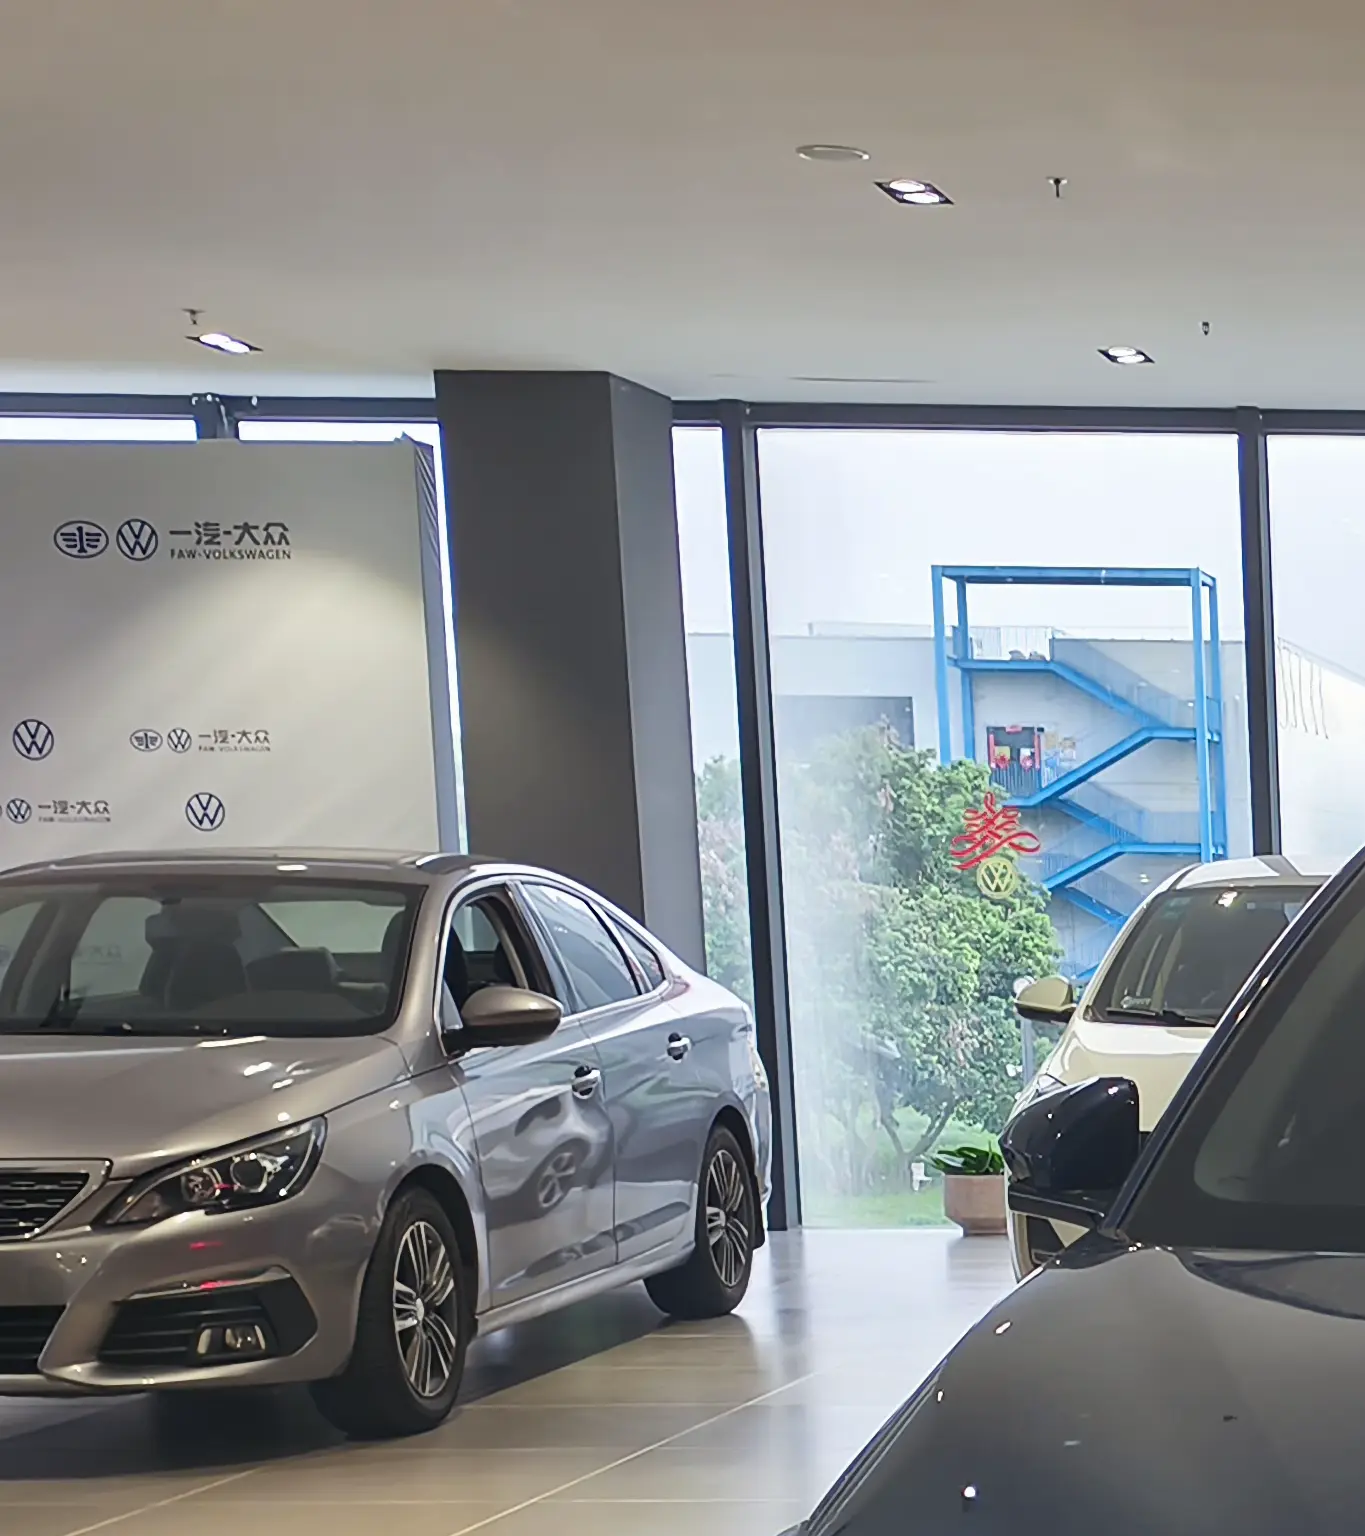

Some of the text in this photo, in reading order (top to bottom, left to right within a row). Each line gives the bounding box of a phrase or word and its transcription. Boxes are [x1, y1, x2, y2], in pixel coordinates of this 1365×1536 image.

[168, 521, 291, 546] 一汽-大众
[169, 548, 292, 561] FAW-VOLKSWAGEN
